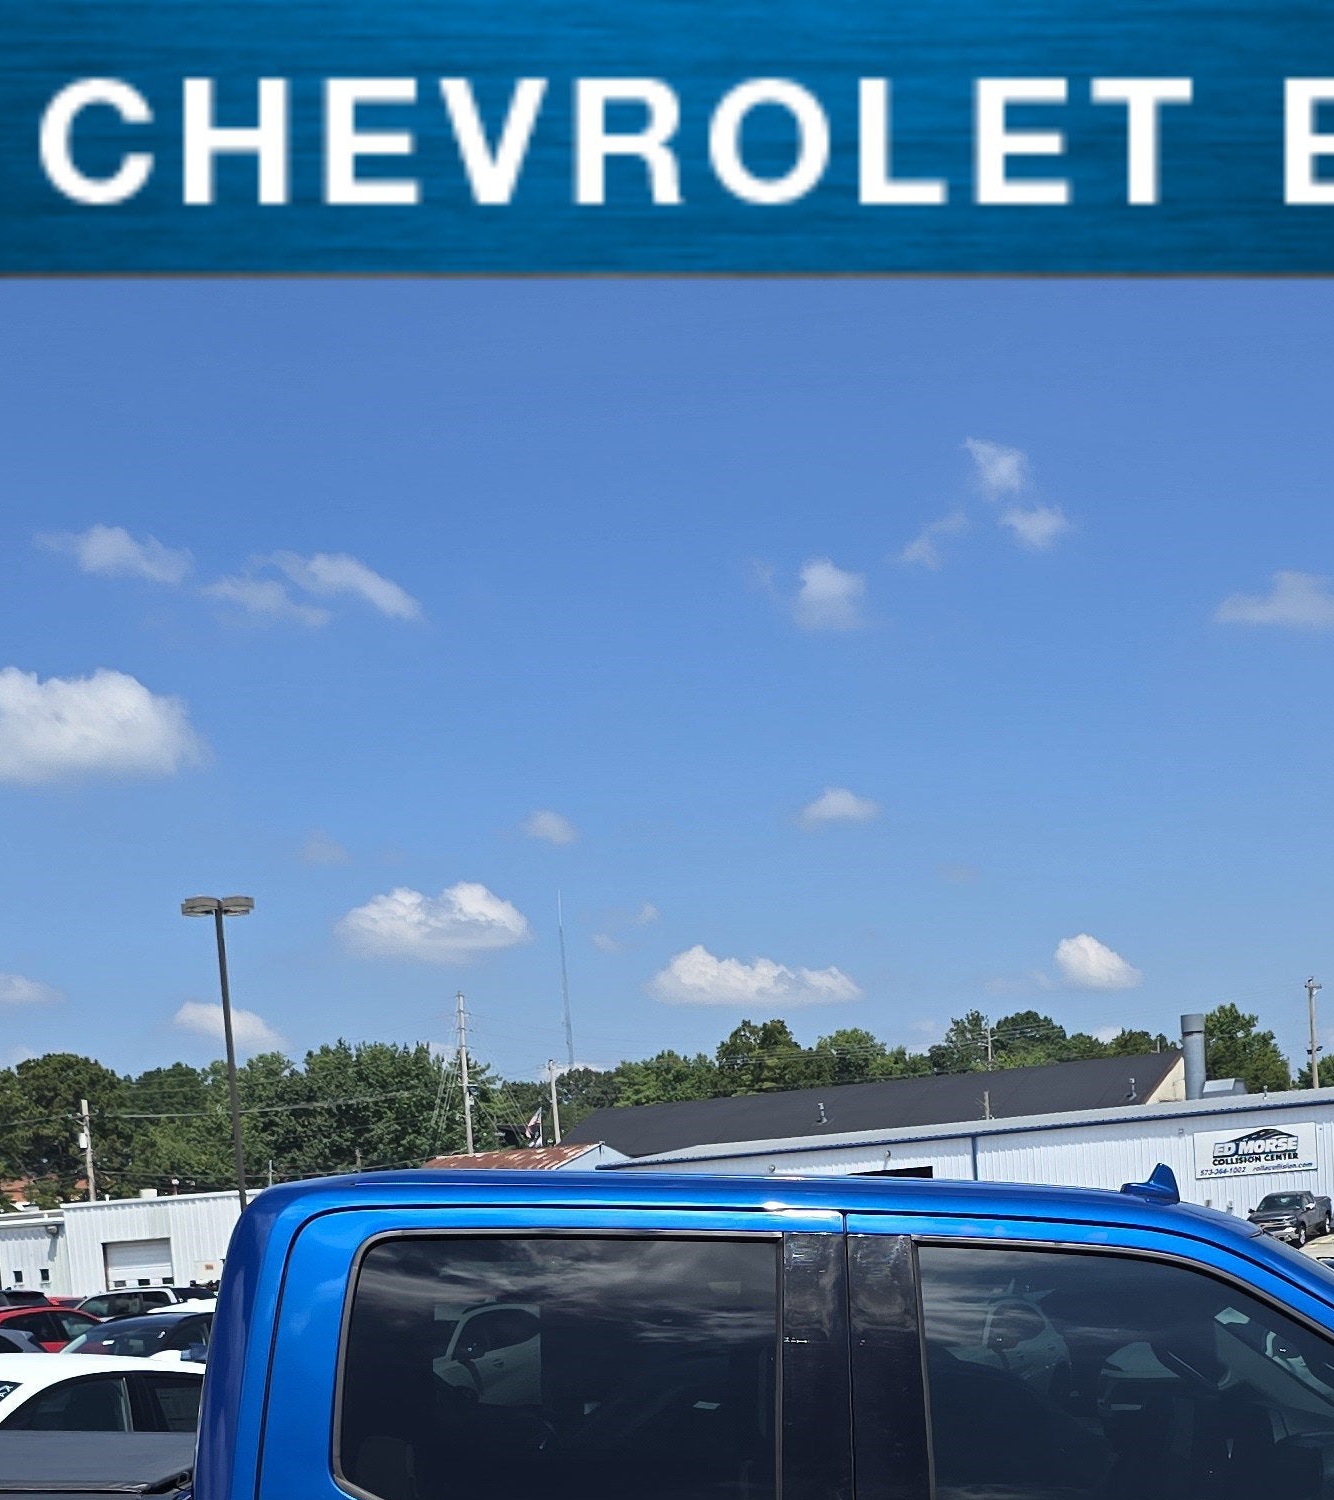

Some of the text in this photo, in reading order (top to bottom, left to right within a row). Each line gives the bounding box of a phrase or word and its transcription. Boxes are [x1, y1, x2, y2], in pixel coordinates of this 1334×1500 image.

[1213, 1136, 1298, 1158] ED MORSE
[1212, 1152, 1299, 1166] COLLISION CENTER
